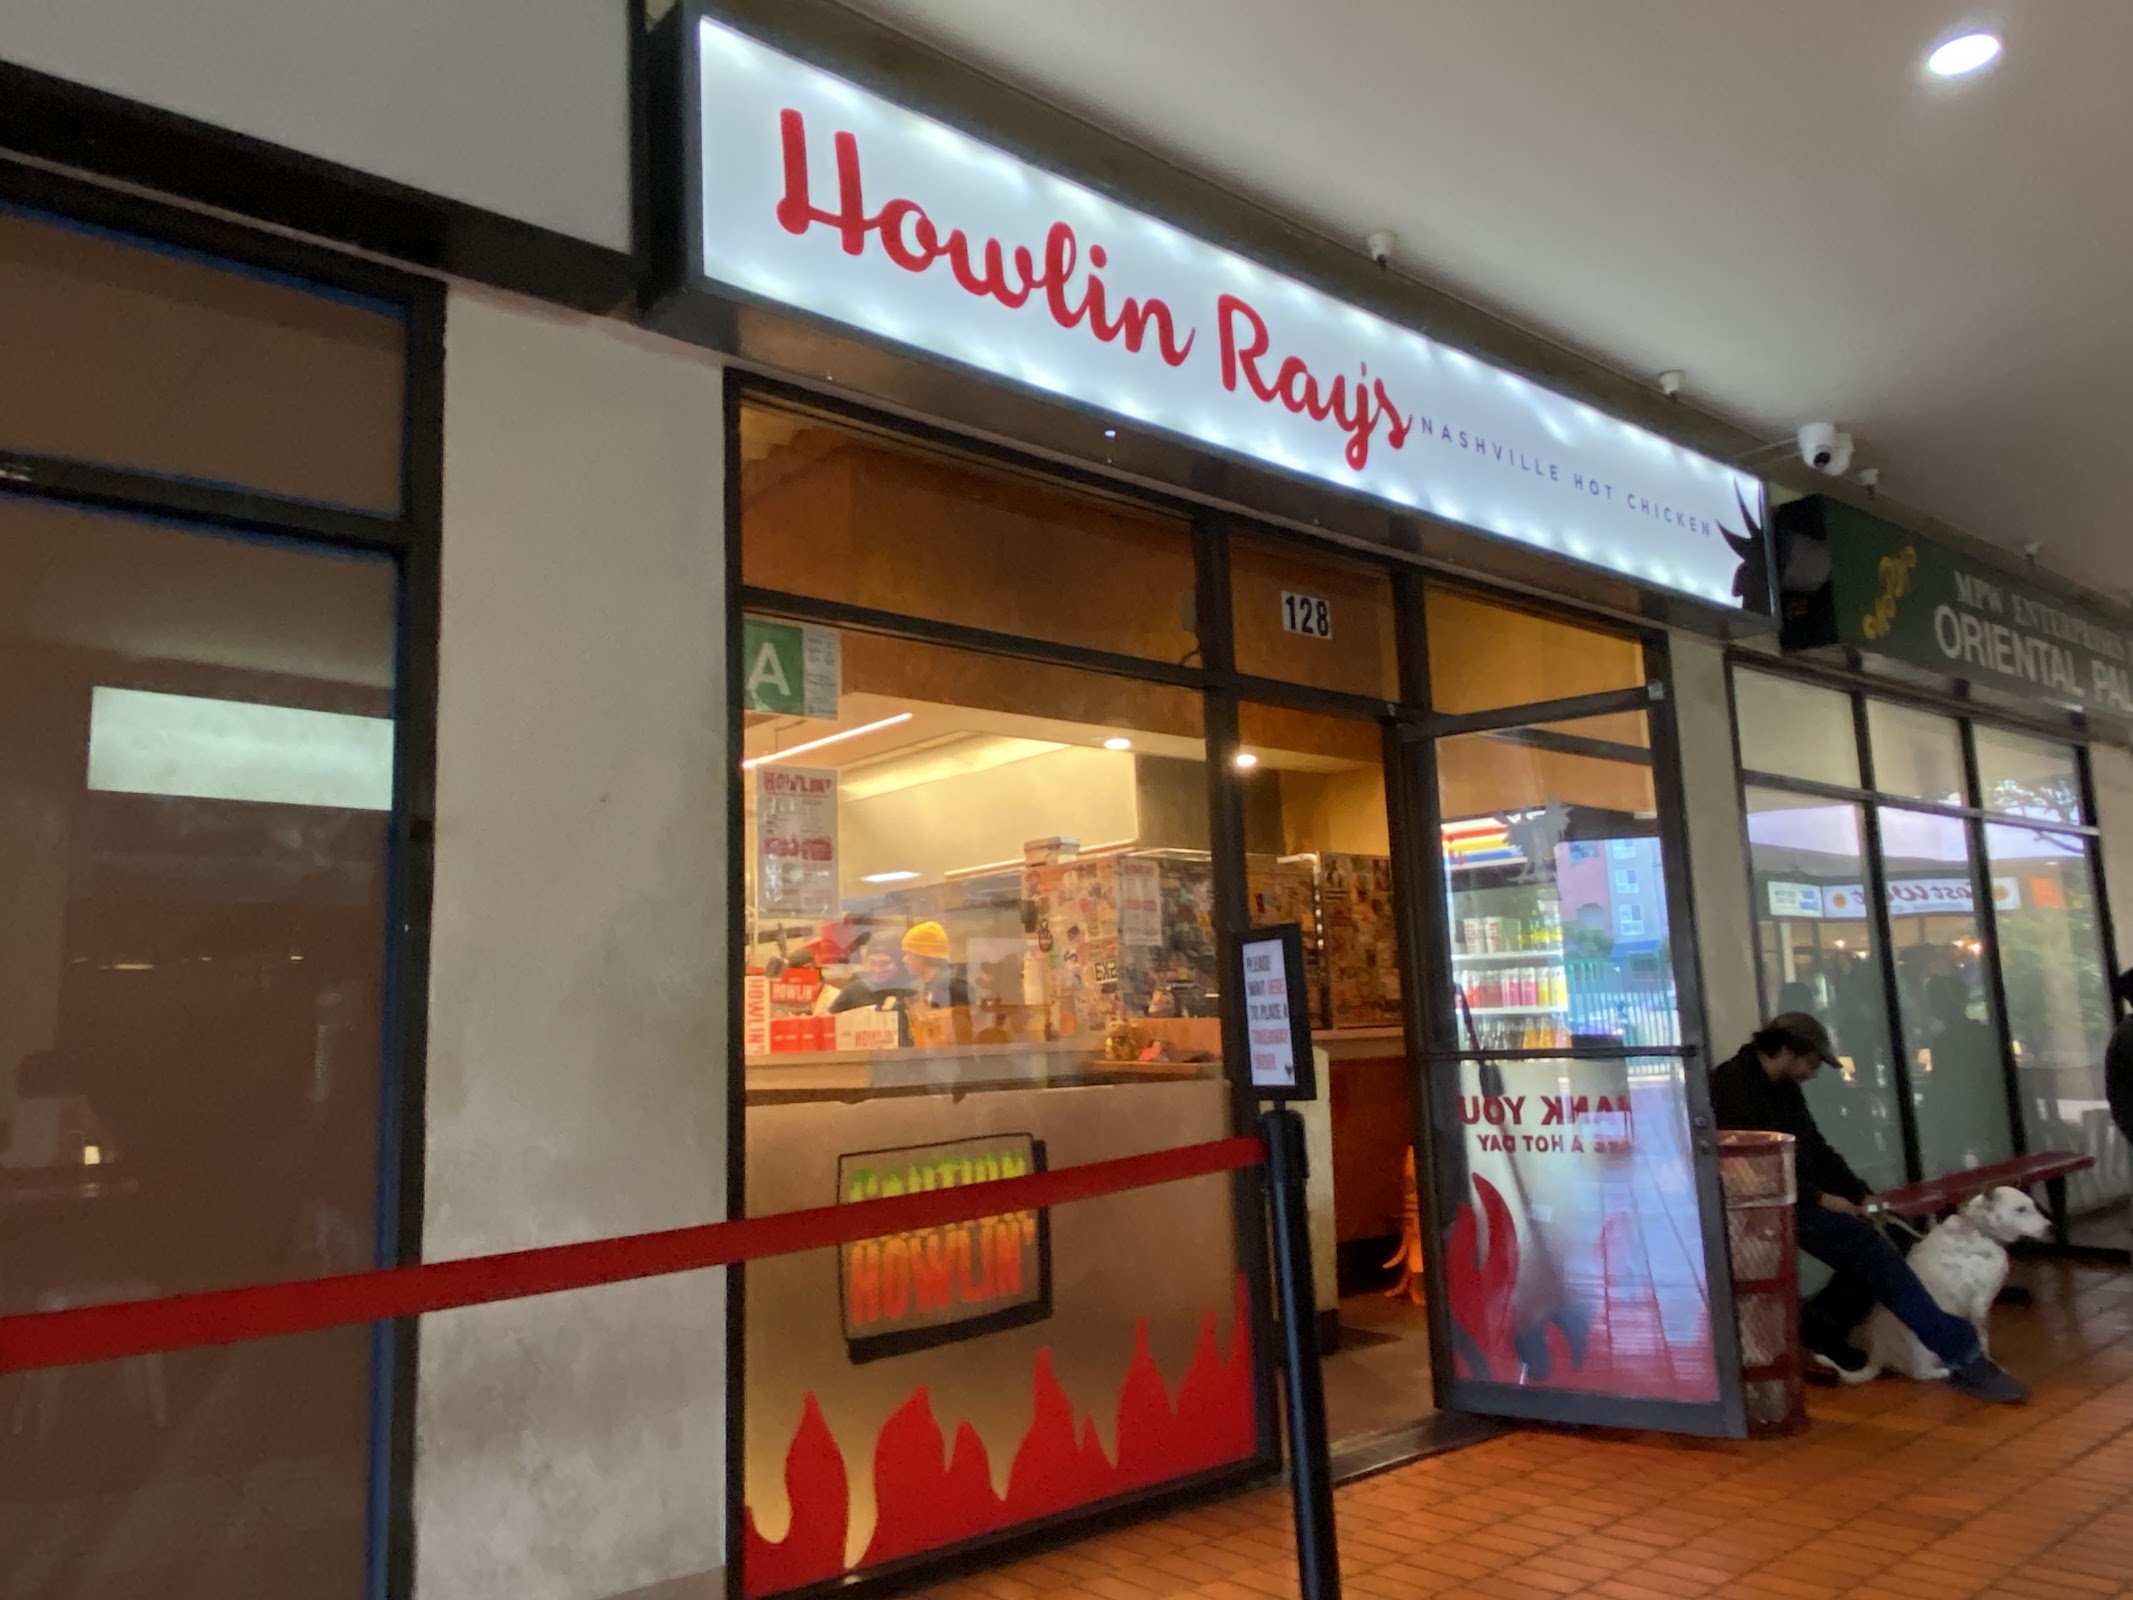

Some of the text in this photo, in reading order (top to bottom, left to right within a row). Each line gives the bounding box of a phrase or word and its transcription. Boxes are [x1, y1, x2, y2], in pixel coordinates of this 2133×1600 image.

[777, 108, 1412, 471] Howlin Ray's
[1421, 416, 1711, 537] NASHVILLE HOT CHICKEN
[1286, 595, 1328, 636] 128
[1934, 604, 2086, 698] ORIENTAL
[744, 640, 792, 697] A
